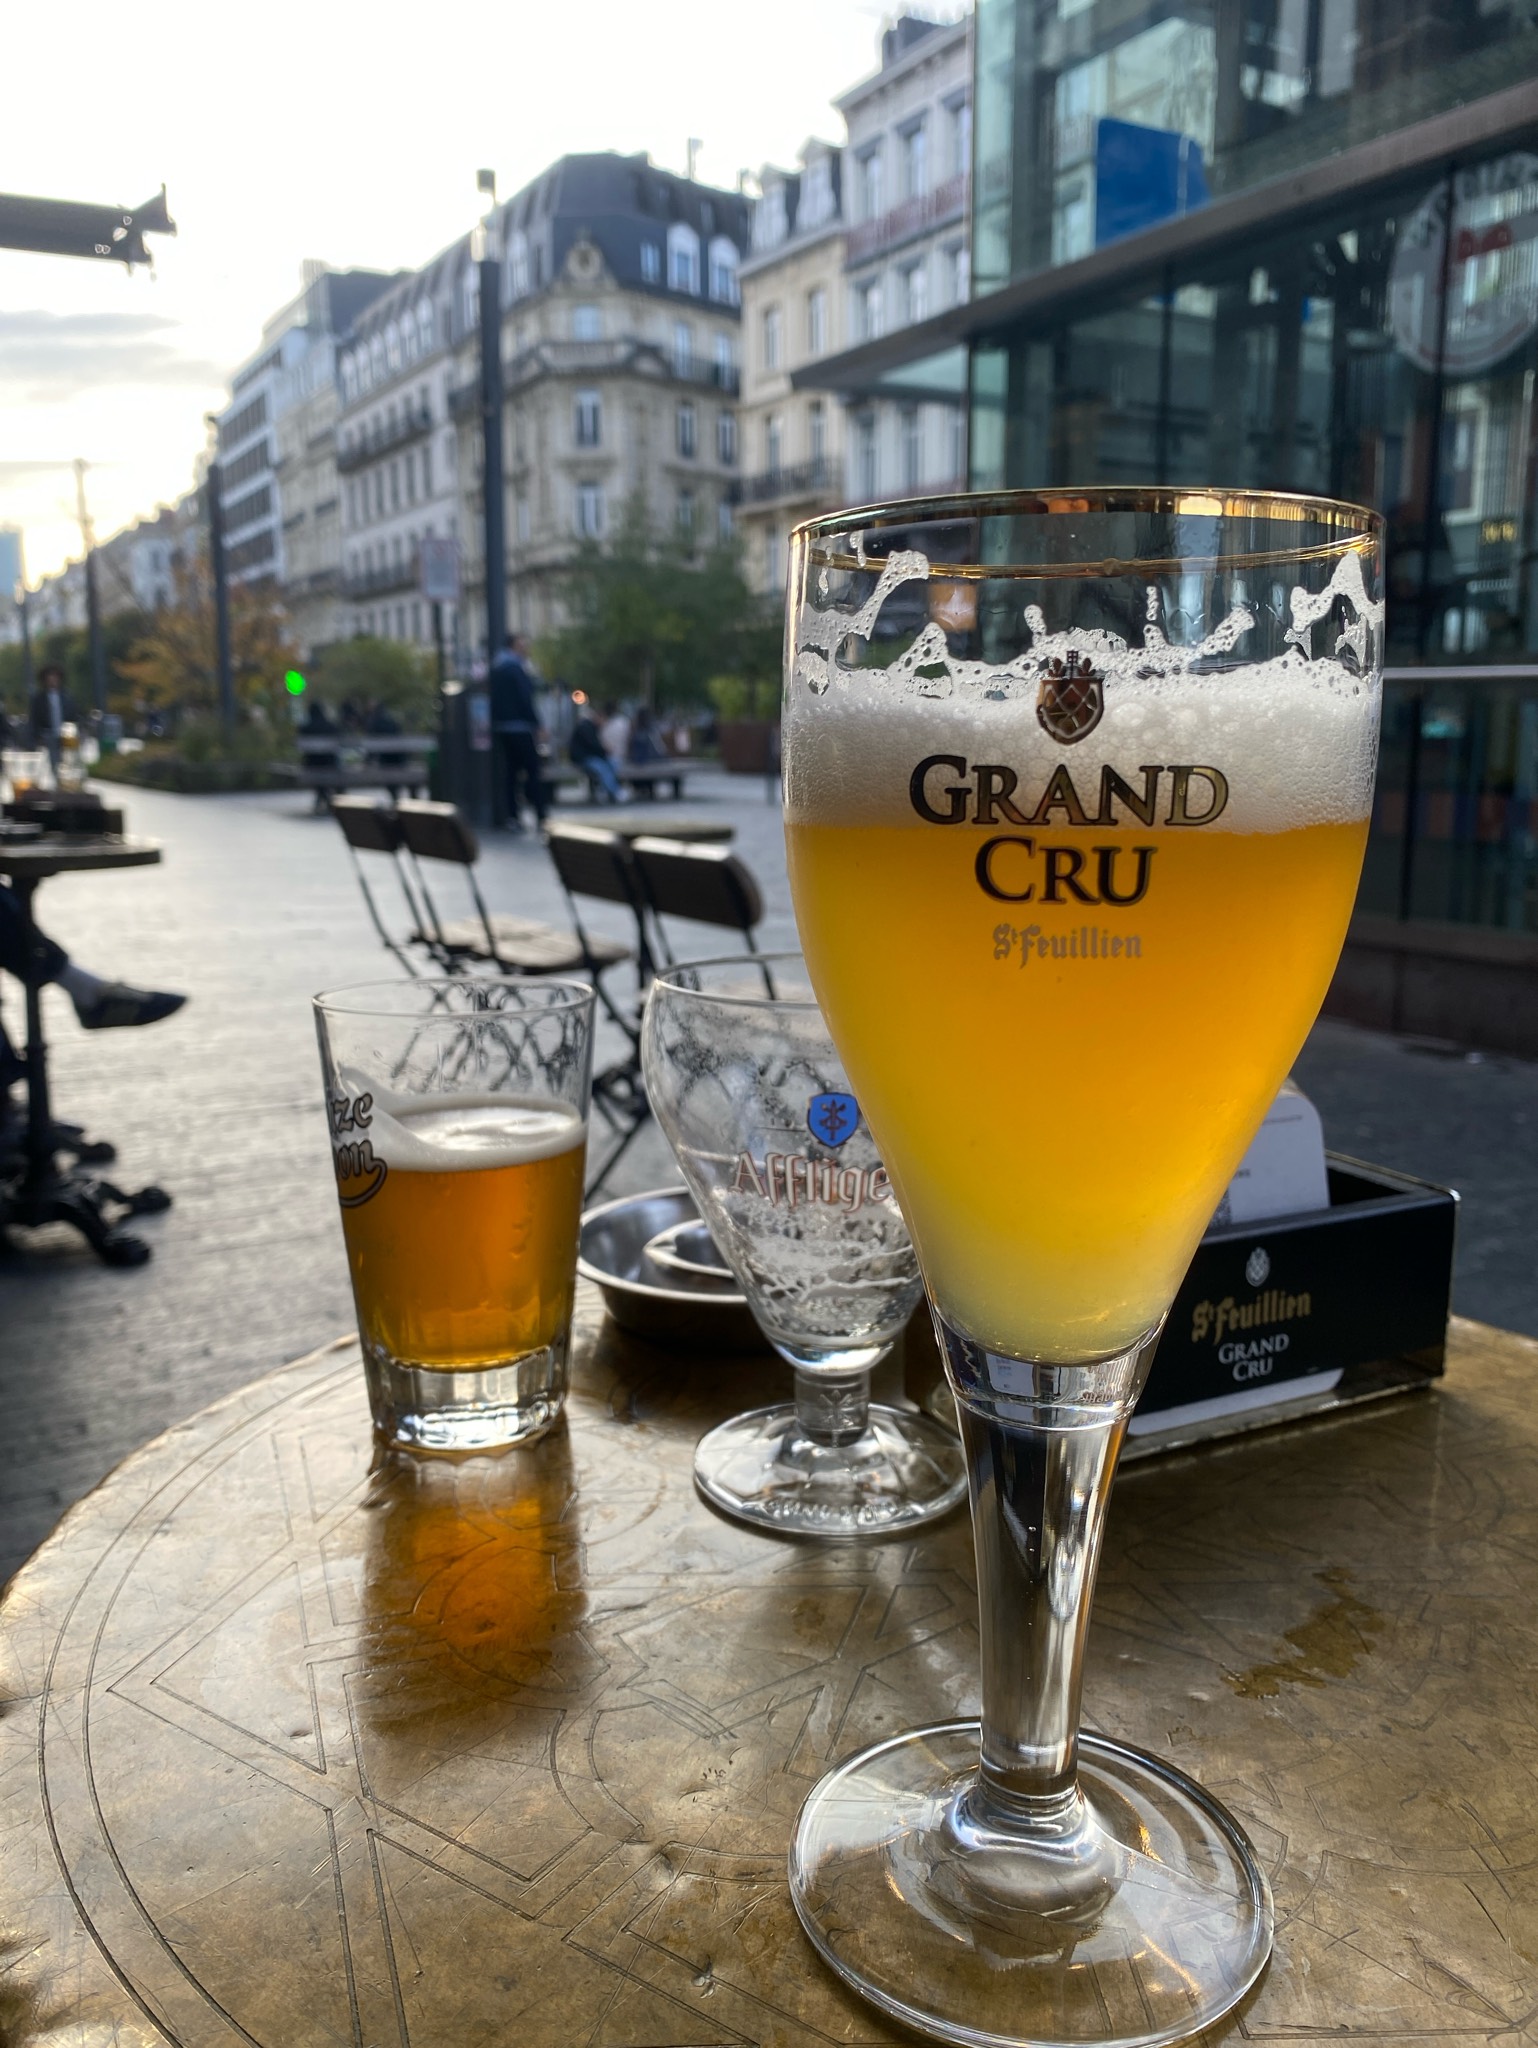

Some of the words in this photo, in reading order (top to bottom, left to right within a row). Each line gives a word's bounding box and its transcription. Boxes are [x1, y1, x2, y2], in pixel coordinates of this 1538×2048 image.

[910, 755, 1229, 827] GRAND
[974, 835, 1158, 907] CRU
[330, 1092, 373, 1133] ze
[334, 1139, 387, 1182] on
[729, 1151, 890, 1213] Afflige
[1218, 1333, 1290, 1364] GRAND
[1232, 1357, 1273, 1382] CRU
